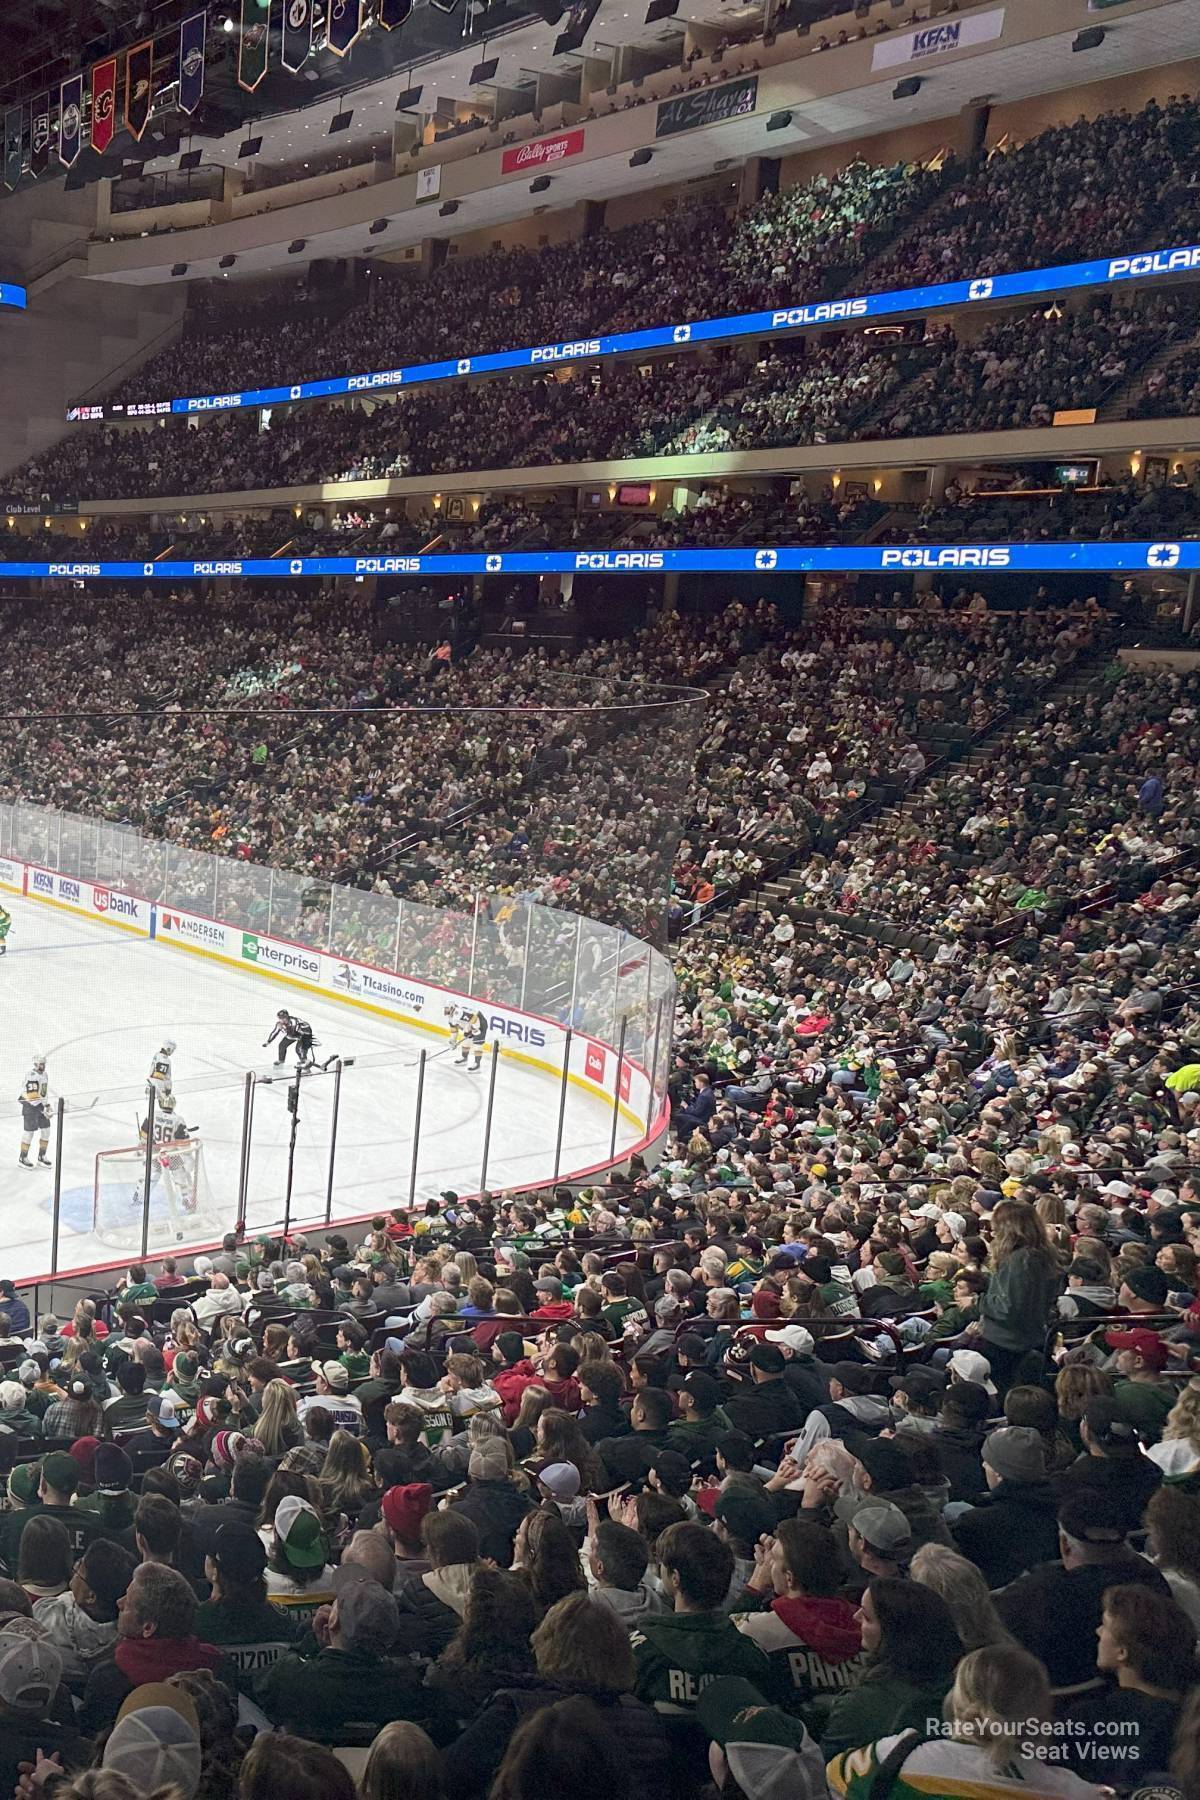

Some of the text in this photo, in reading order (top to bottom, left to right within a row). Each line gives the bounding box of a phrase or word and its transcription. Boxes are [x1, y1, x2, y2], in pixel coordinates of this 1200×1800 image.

[517, 143, 545, 163] Bally
[772, 299, 868, 327] POLARIS
[530, 340, 601, 362] POLARIS
[347, 371, 402, 390] POLARIS
[188, 395, 242, 410] POLARIS
[5, 503, 41, 513] Club Level
[355, 558, 421, 572] POLARIS
[575, 553, 664, 569] POLARIS
[881, 547, 1010, 567] POLARIS
[49, 564, 101, 576] POLARIS
[193, 562, 242, 575] POLARIS
[110, 892, 138, 918] bank
[181, 920, 225, 940] ANDERSEN
[244, 941, 319, 973] enterprise
